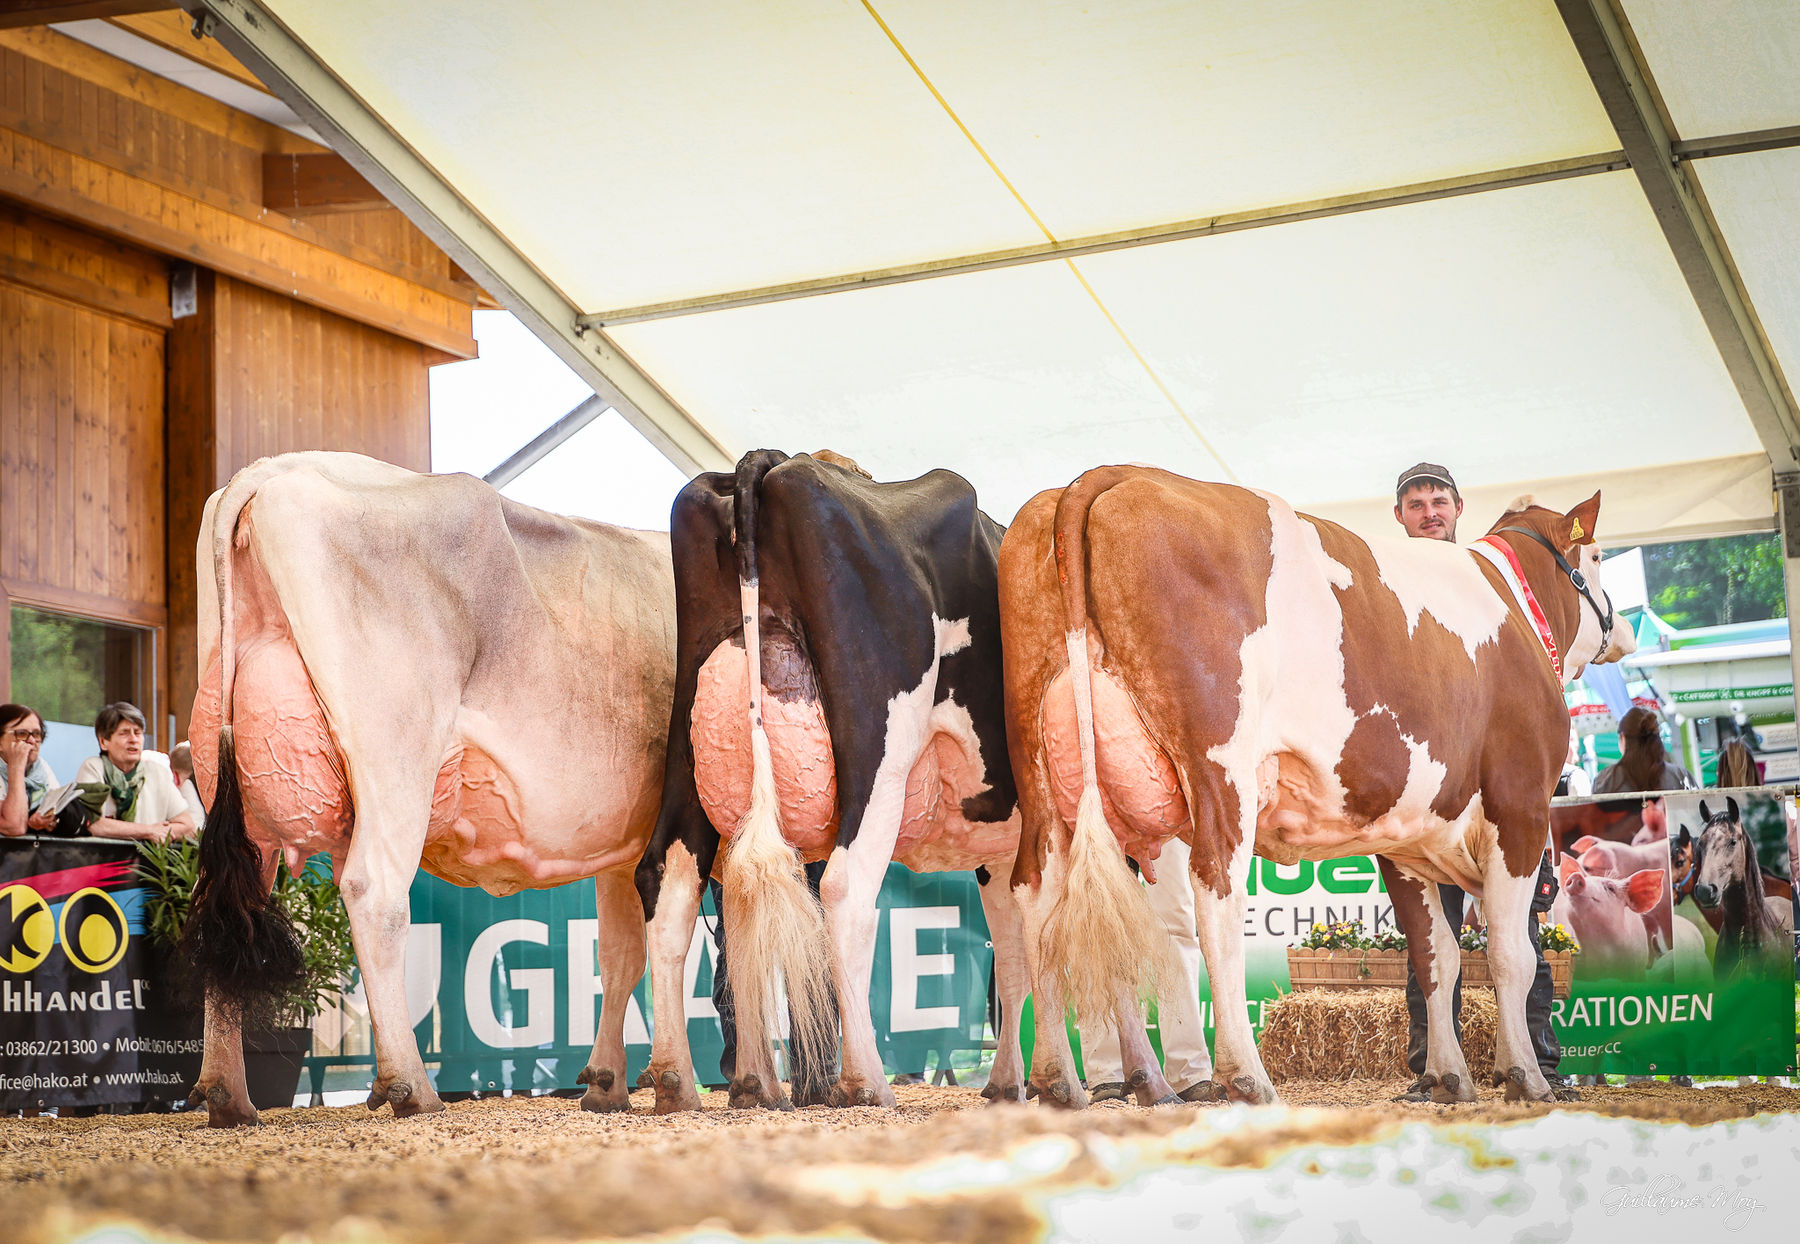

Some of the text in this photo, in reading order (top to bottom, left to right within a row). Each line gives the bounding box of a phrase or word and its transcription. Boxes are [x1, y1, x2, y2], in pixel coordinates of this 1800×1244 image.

[1550, 993, 1713, 1027] RATIONEN
[6, 1040, 98, 1056] 03862/21300
[1560, 1041, 1622, 1057] aeuer.cc
[105, 1068, 184, 1085] www.hako.at
